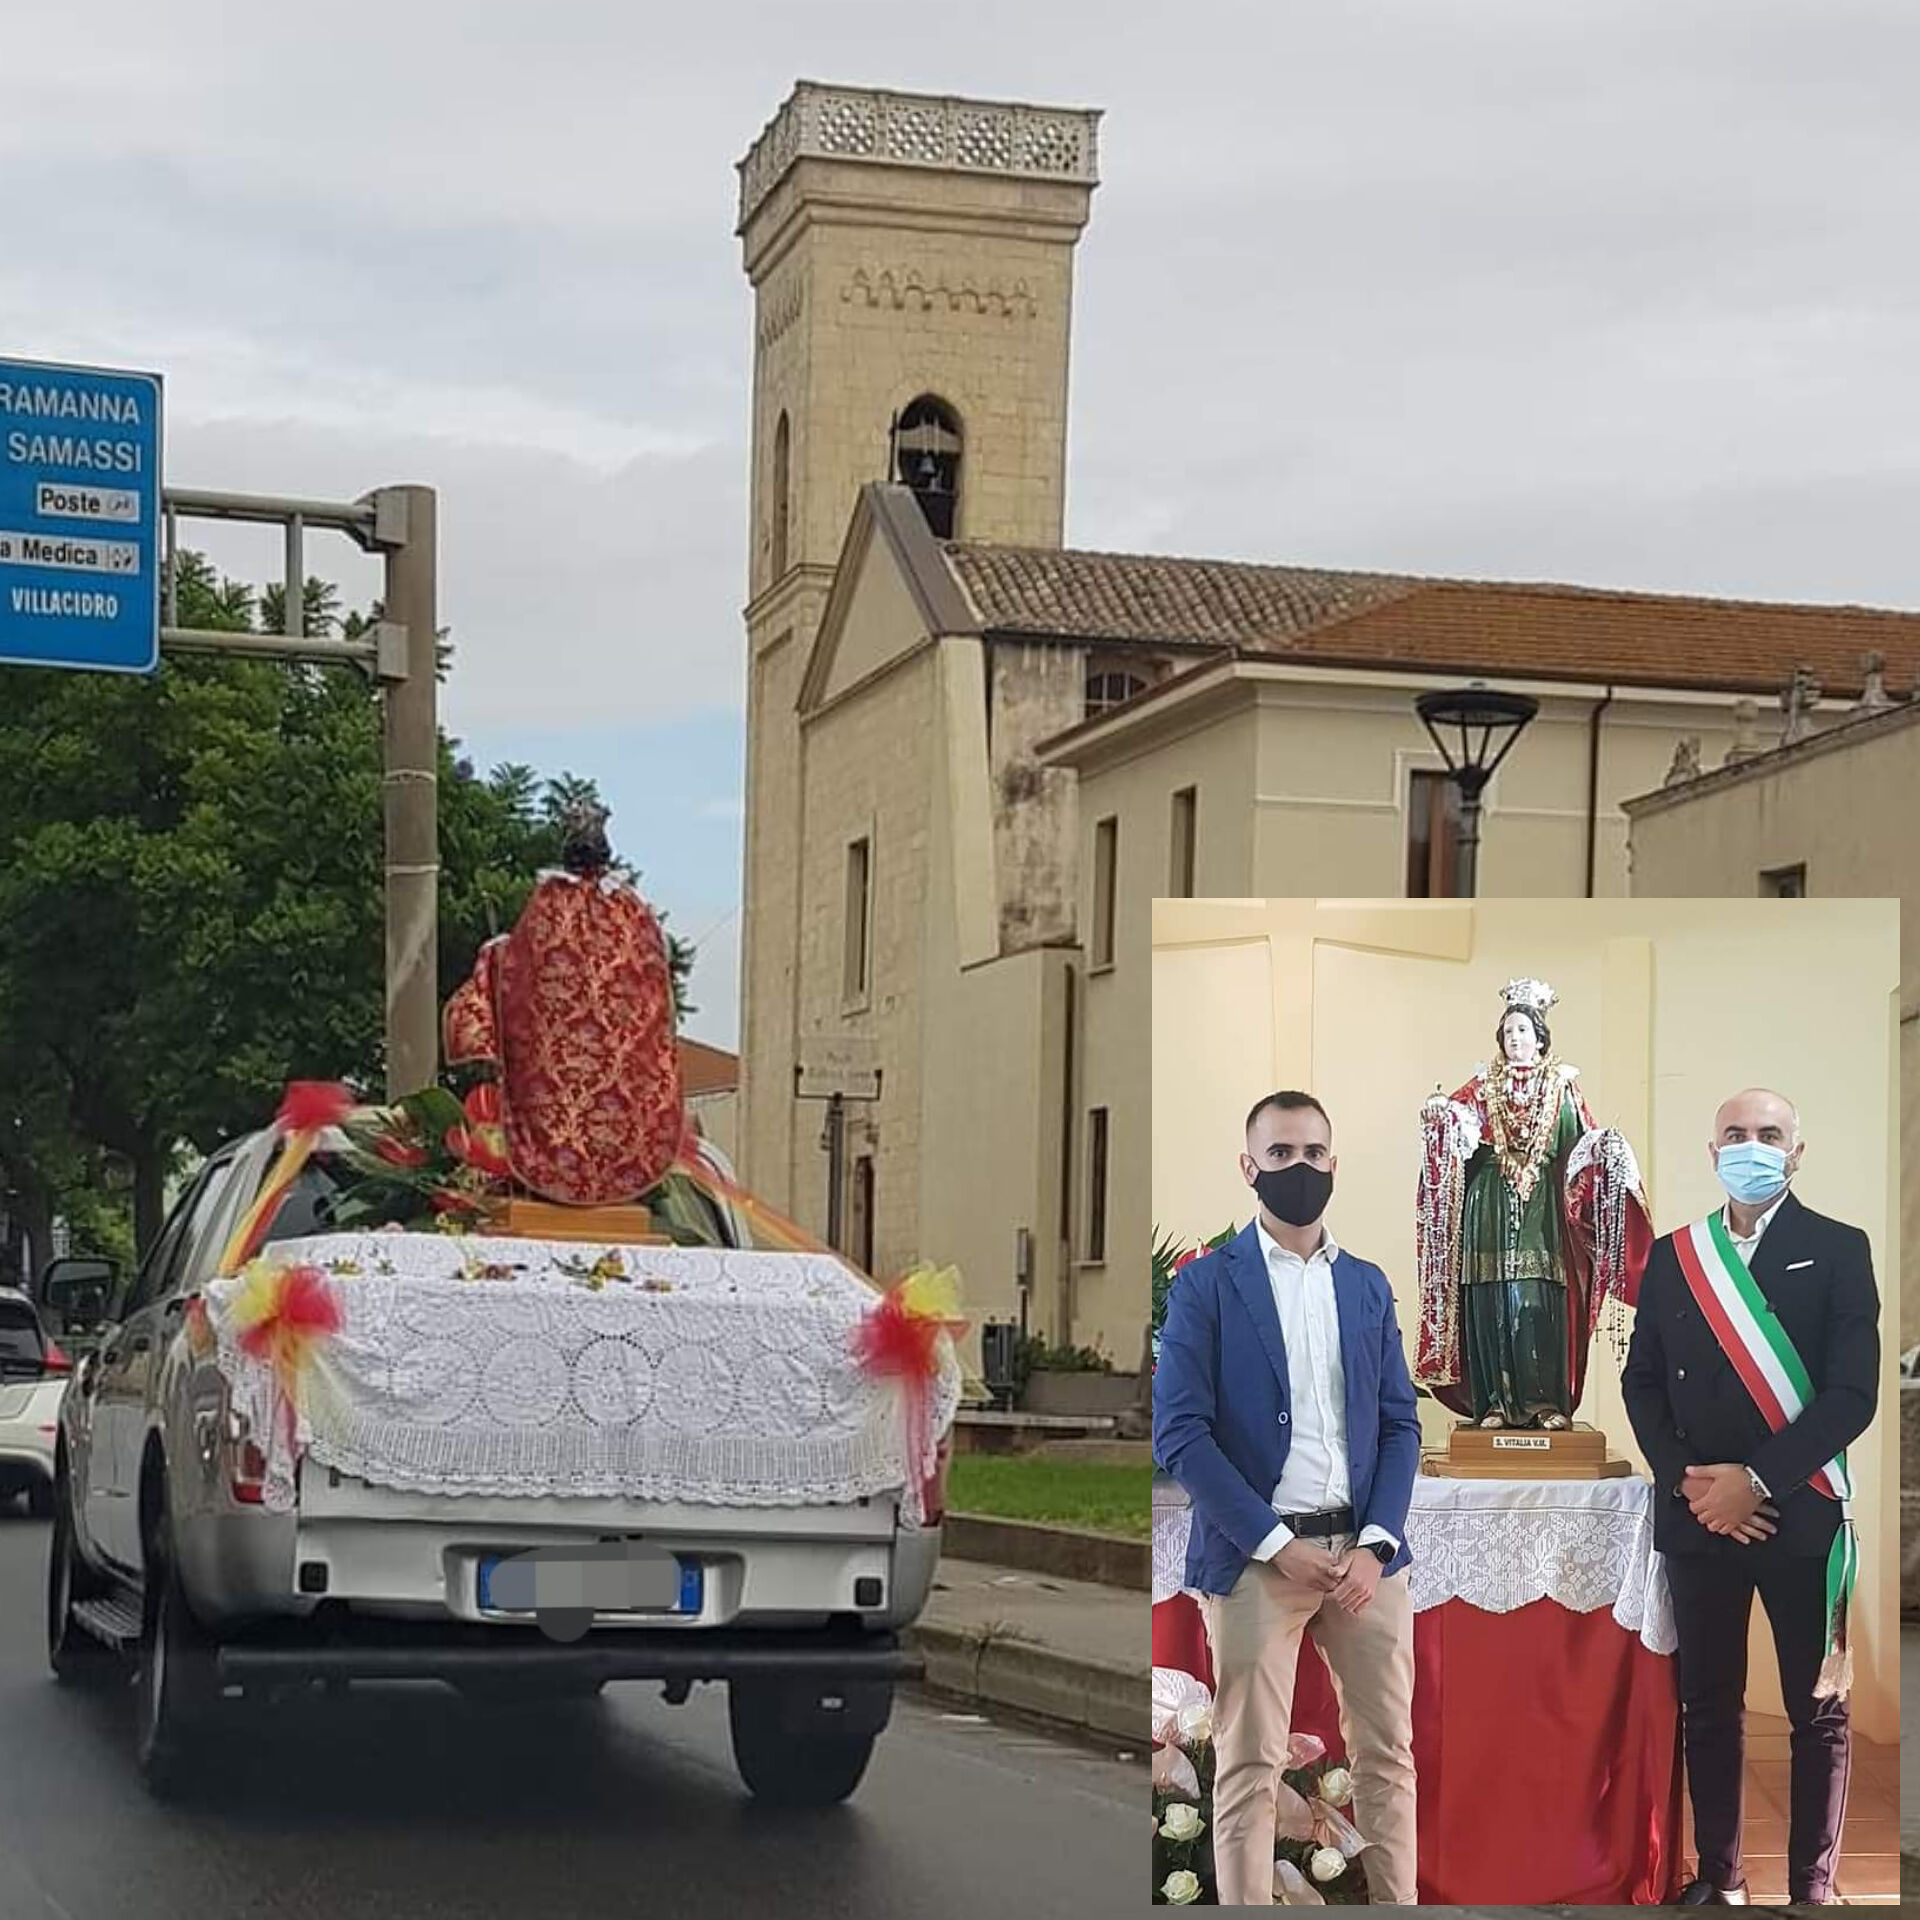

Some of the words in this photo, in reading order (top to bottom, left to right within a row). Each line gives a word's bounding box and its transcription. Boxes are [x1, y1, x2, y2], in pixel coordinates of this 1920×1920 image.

[8, 432, 141, 472] SAMASSI
[41, 488, 101, 513] Poste
[22, 538, 98, 565] Medica
[12, 586, 118, 620] VILLACIDRO
[1495, 1437, 1503, 1446] S.
[1504, 1437, 1531, 1447] VITALIA
